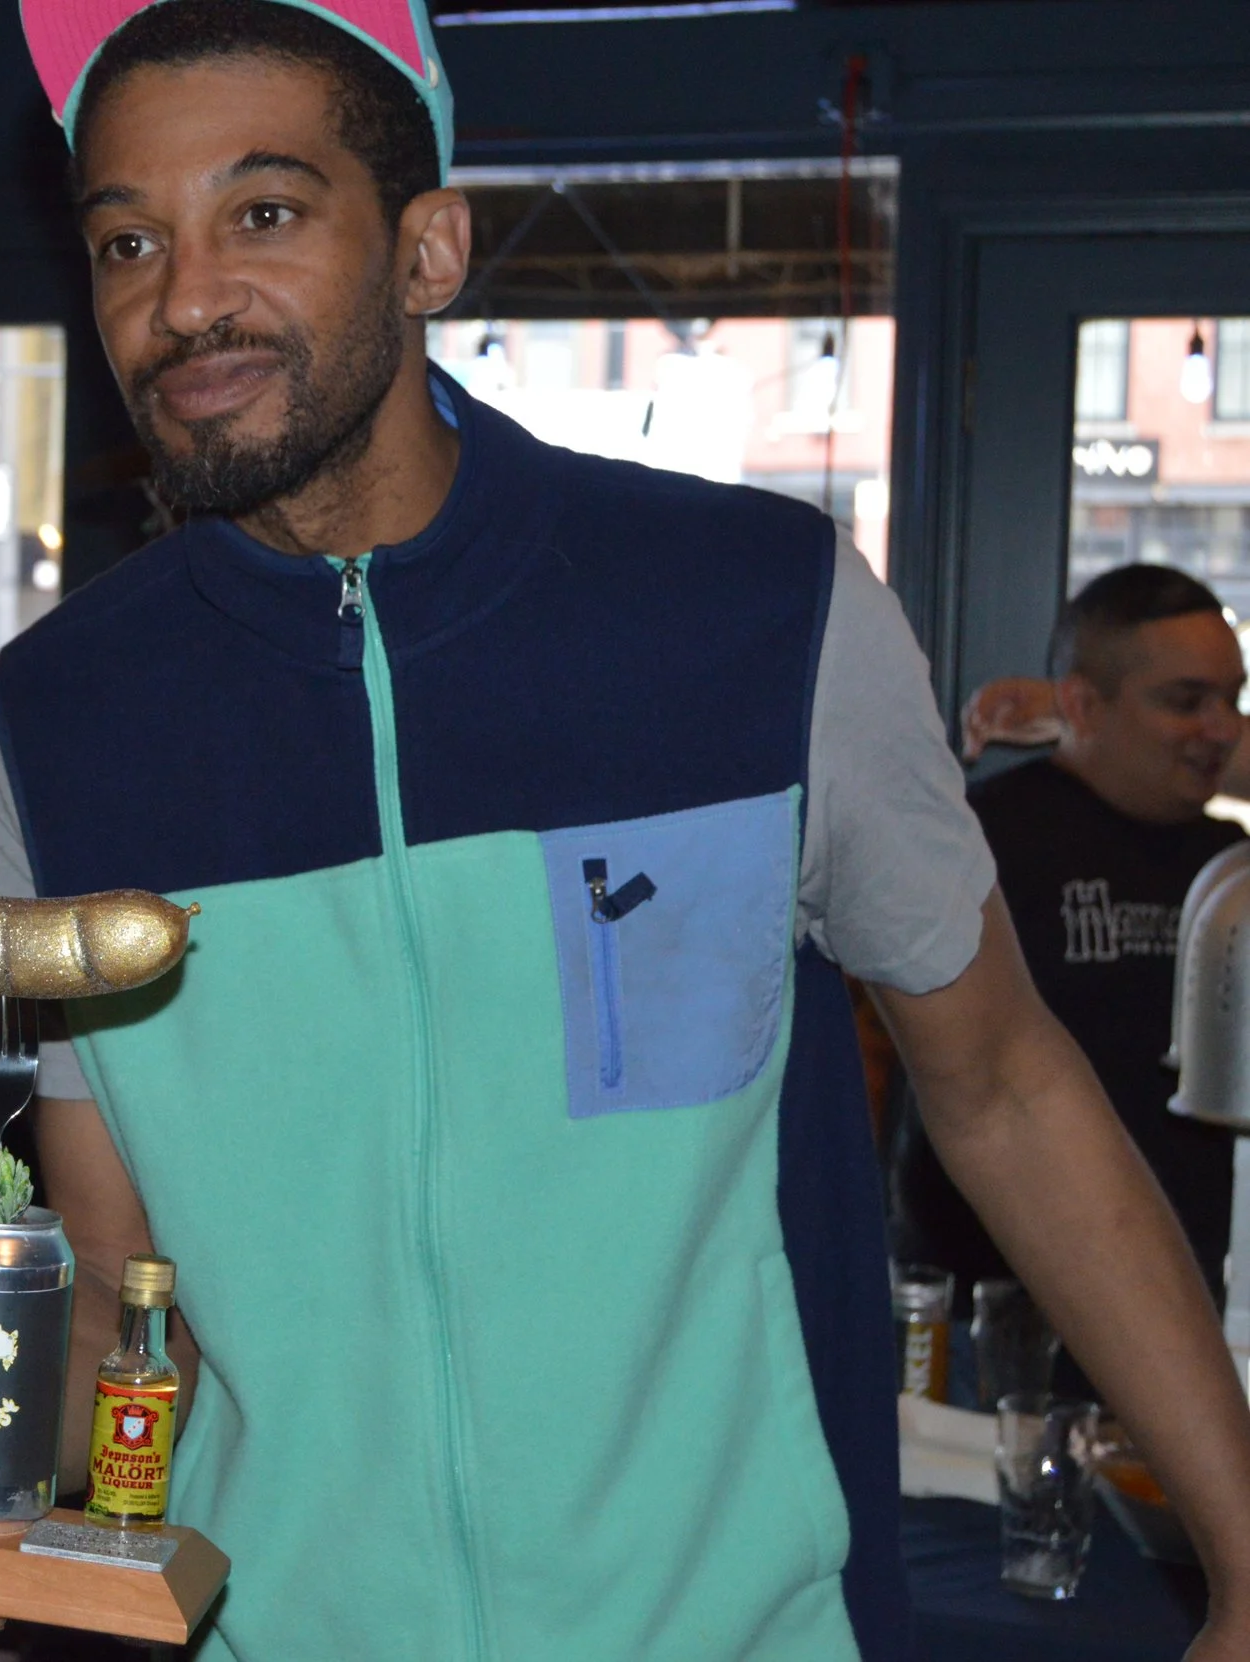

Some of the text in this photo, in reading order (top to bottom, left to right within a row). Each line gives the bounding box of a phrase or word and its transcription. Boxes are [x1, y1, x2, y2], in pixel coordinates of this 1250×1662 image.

[100, 1443, 161, 1463] Jeppson's
[92, 1456, 165, 1480] MALÖRT
[102, 1476, 154, 1489] LIQUEUR
